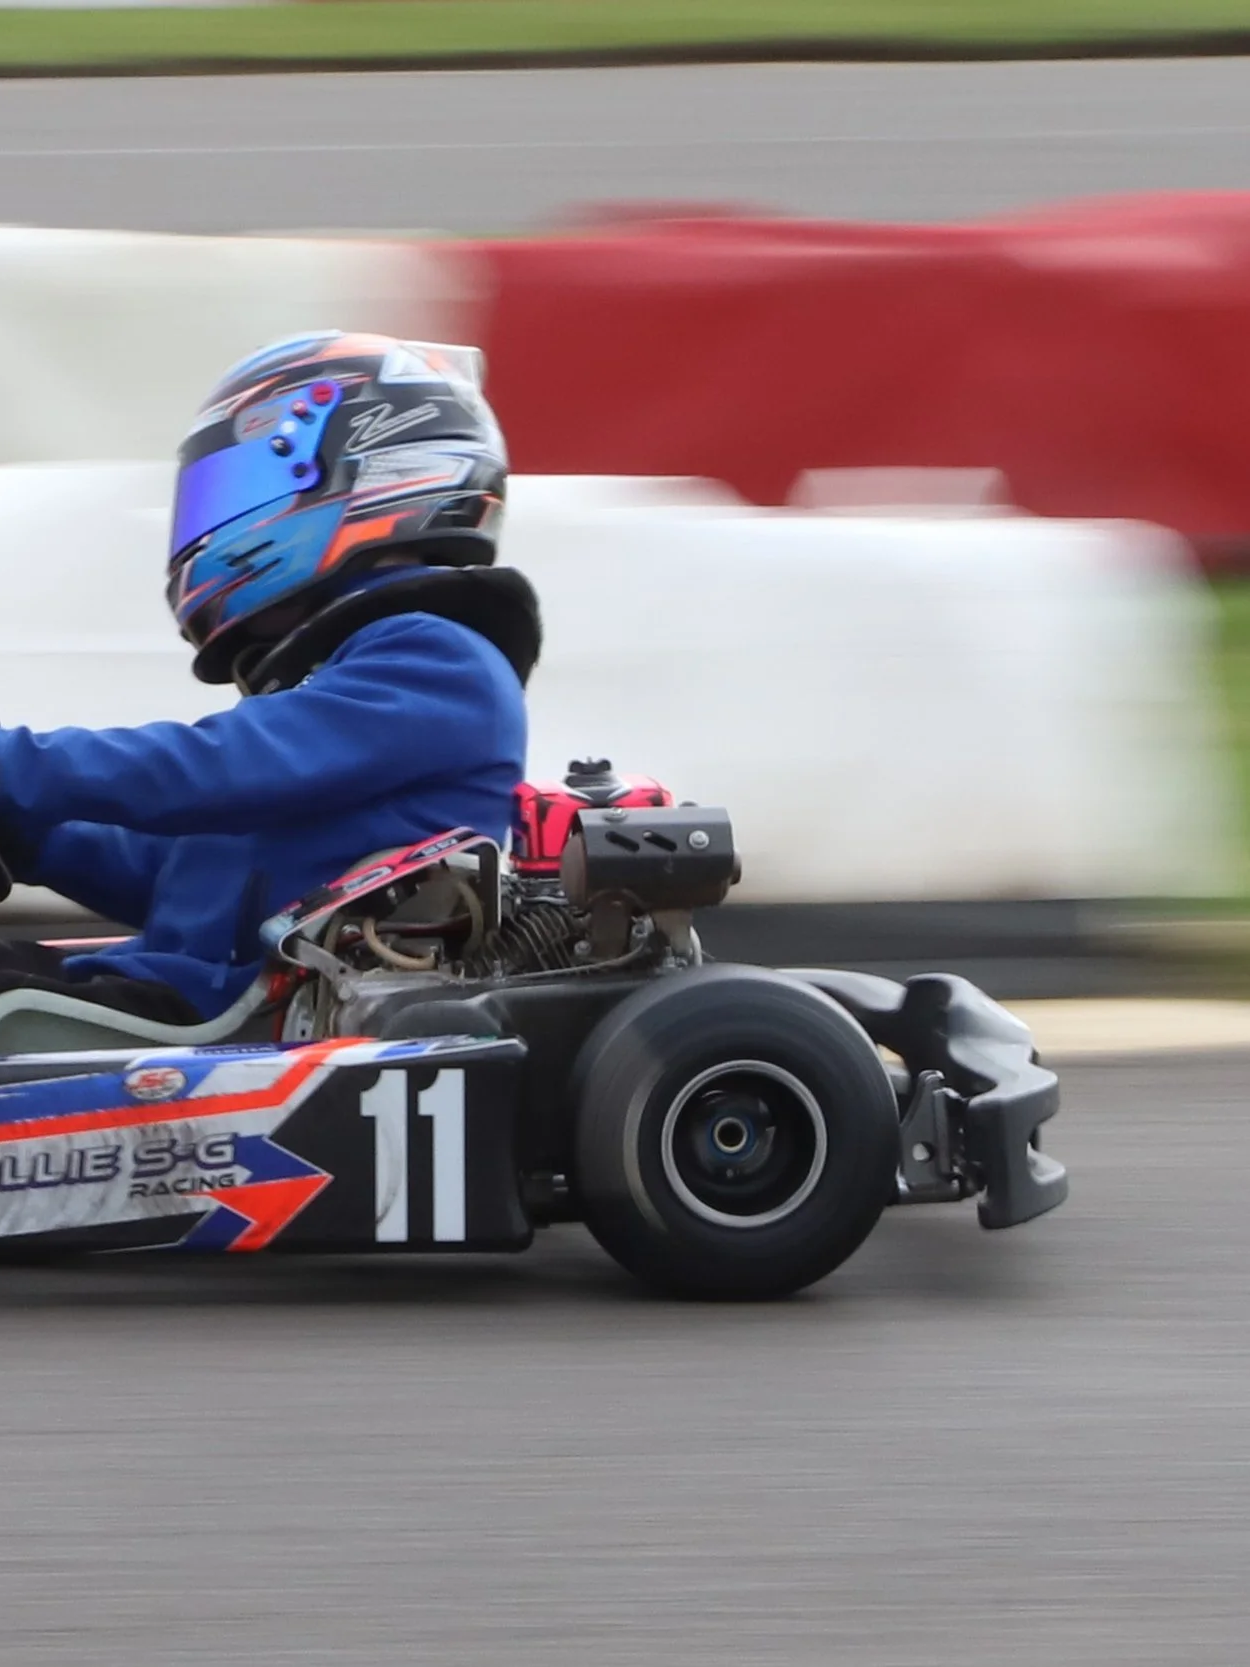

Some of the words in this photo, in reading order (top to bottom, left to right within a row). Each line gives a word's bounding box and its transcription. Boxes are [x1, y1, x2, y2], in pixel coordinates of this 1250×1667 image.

[131, 1131, 240, 1180] S-G
[360, 1068, 466, 1242] 11
[129, 1172, 237, 1199] RACING
